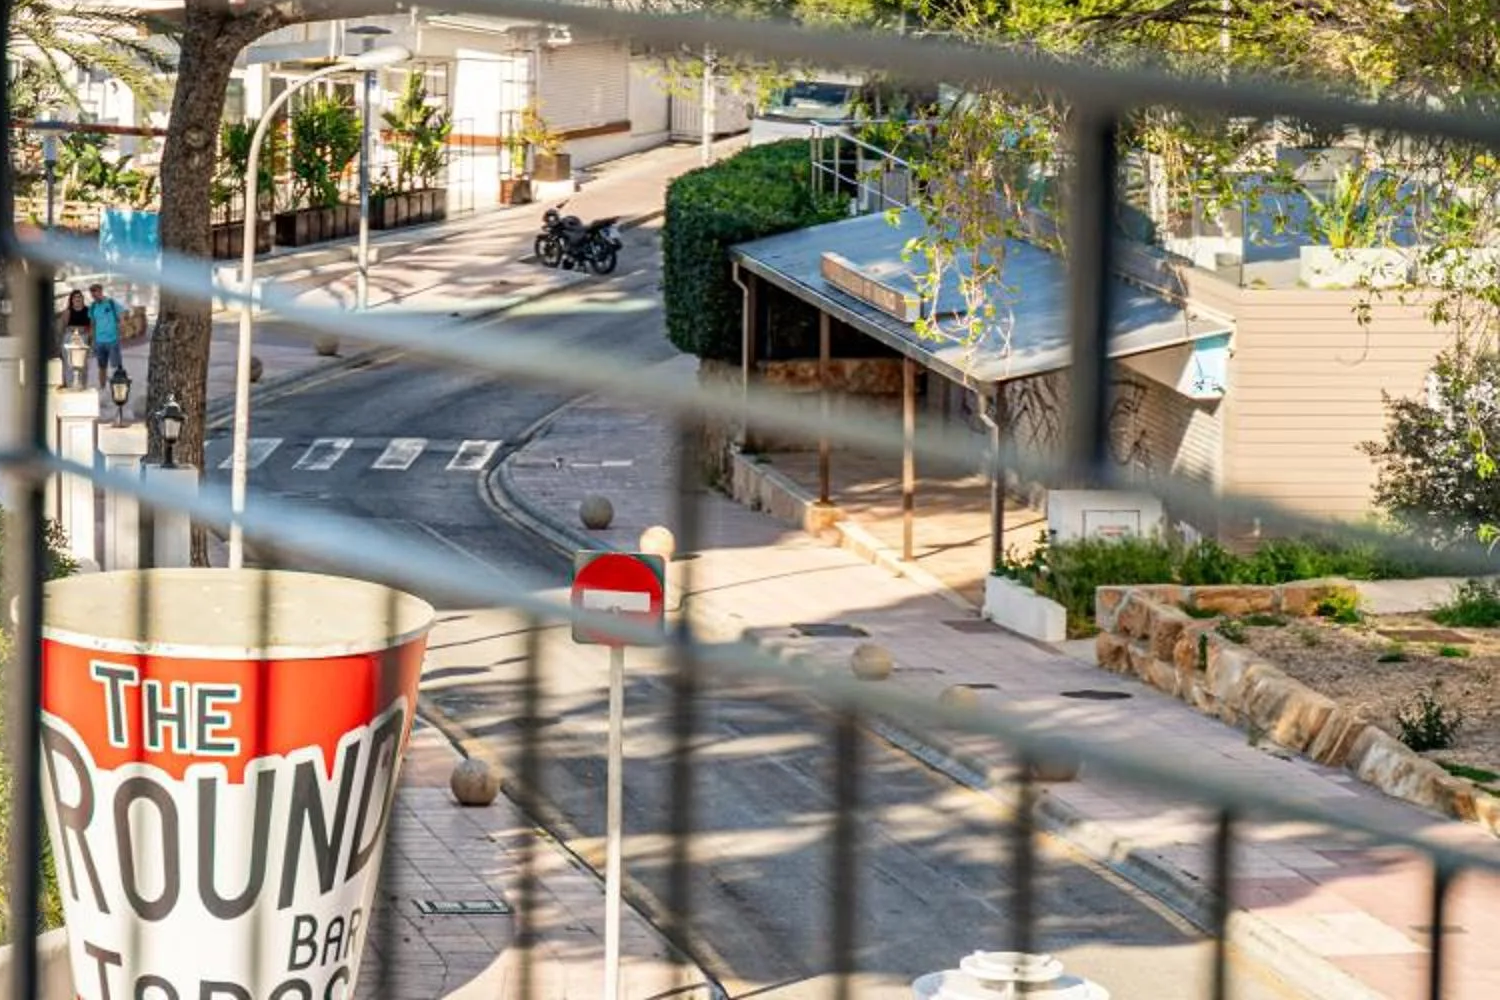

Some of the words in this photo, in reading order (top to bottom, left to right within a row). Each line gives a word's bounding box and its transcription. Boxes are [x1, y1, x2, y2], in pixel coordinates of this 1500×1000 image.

[94, 664, 237, 752] THE
[41, 707, 404, 922] ROUND
[287, 908, 363, 972] BAR
